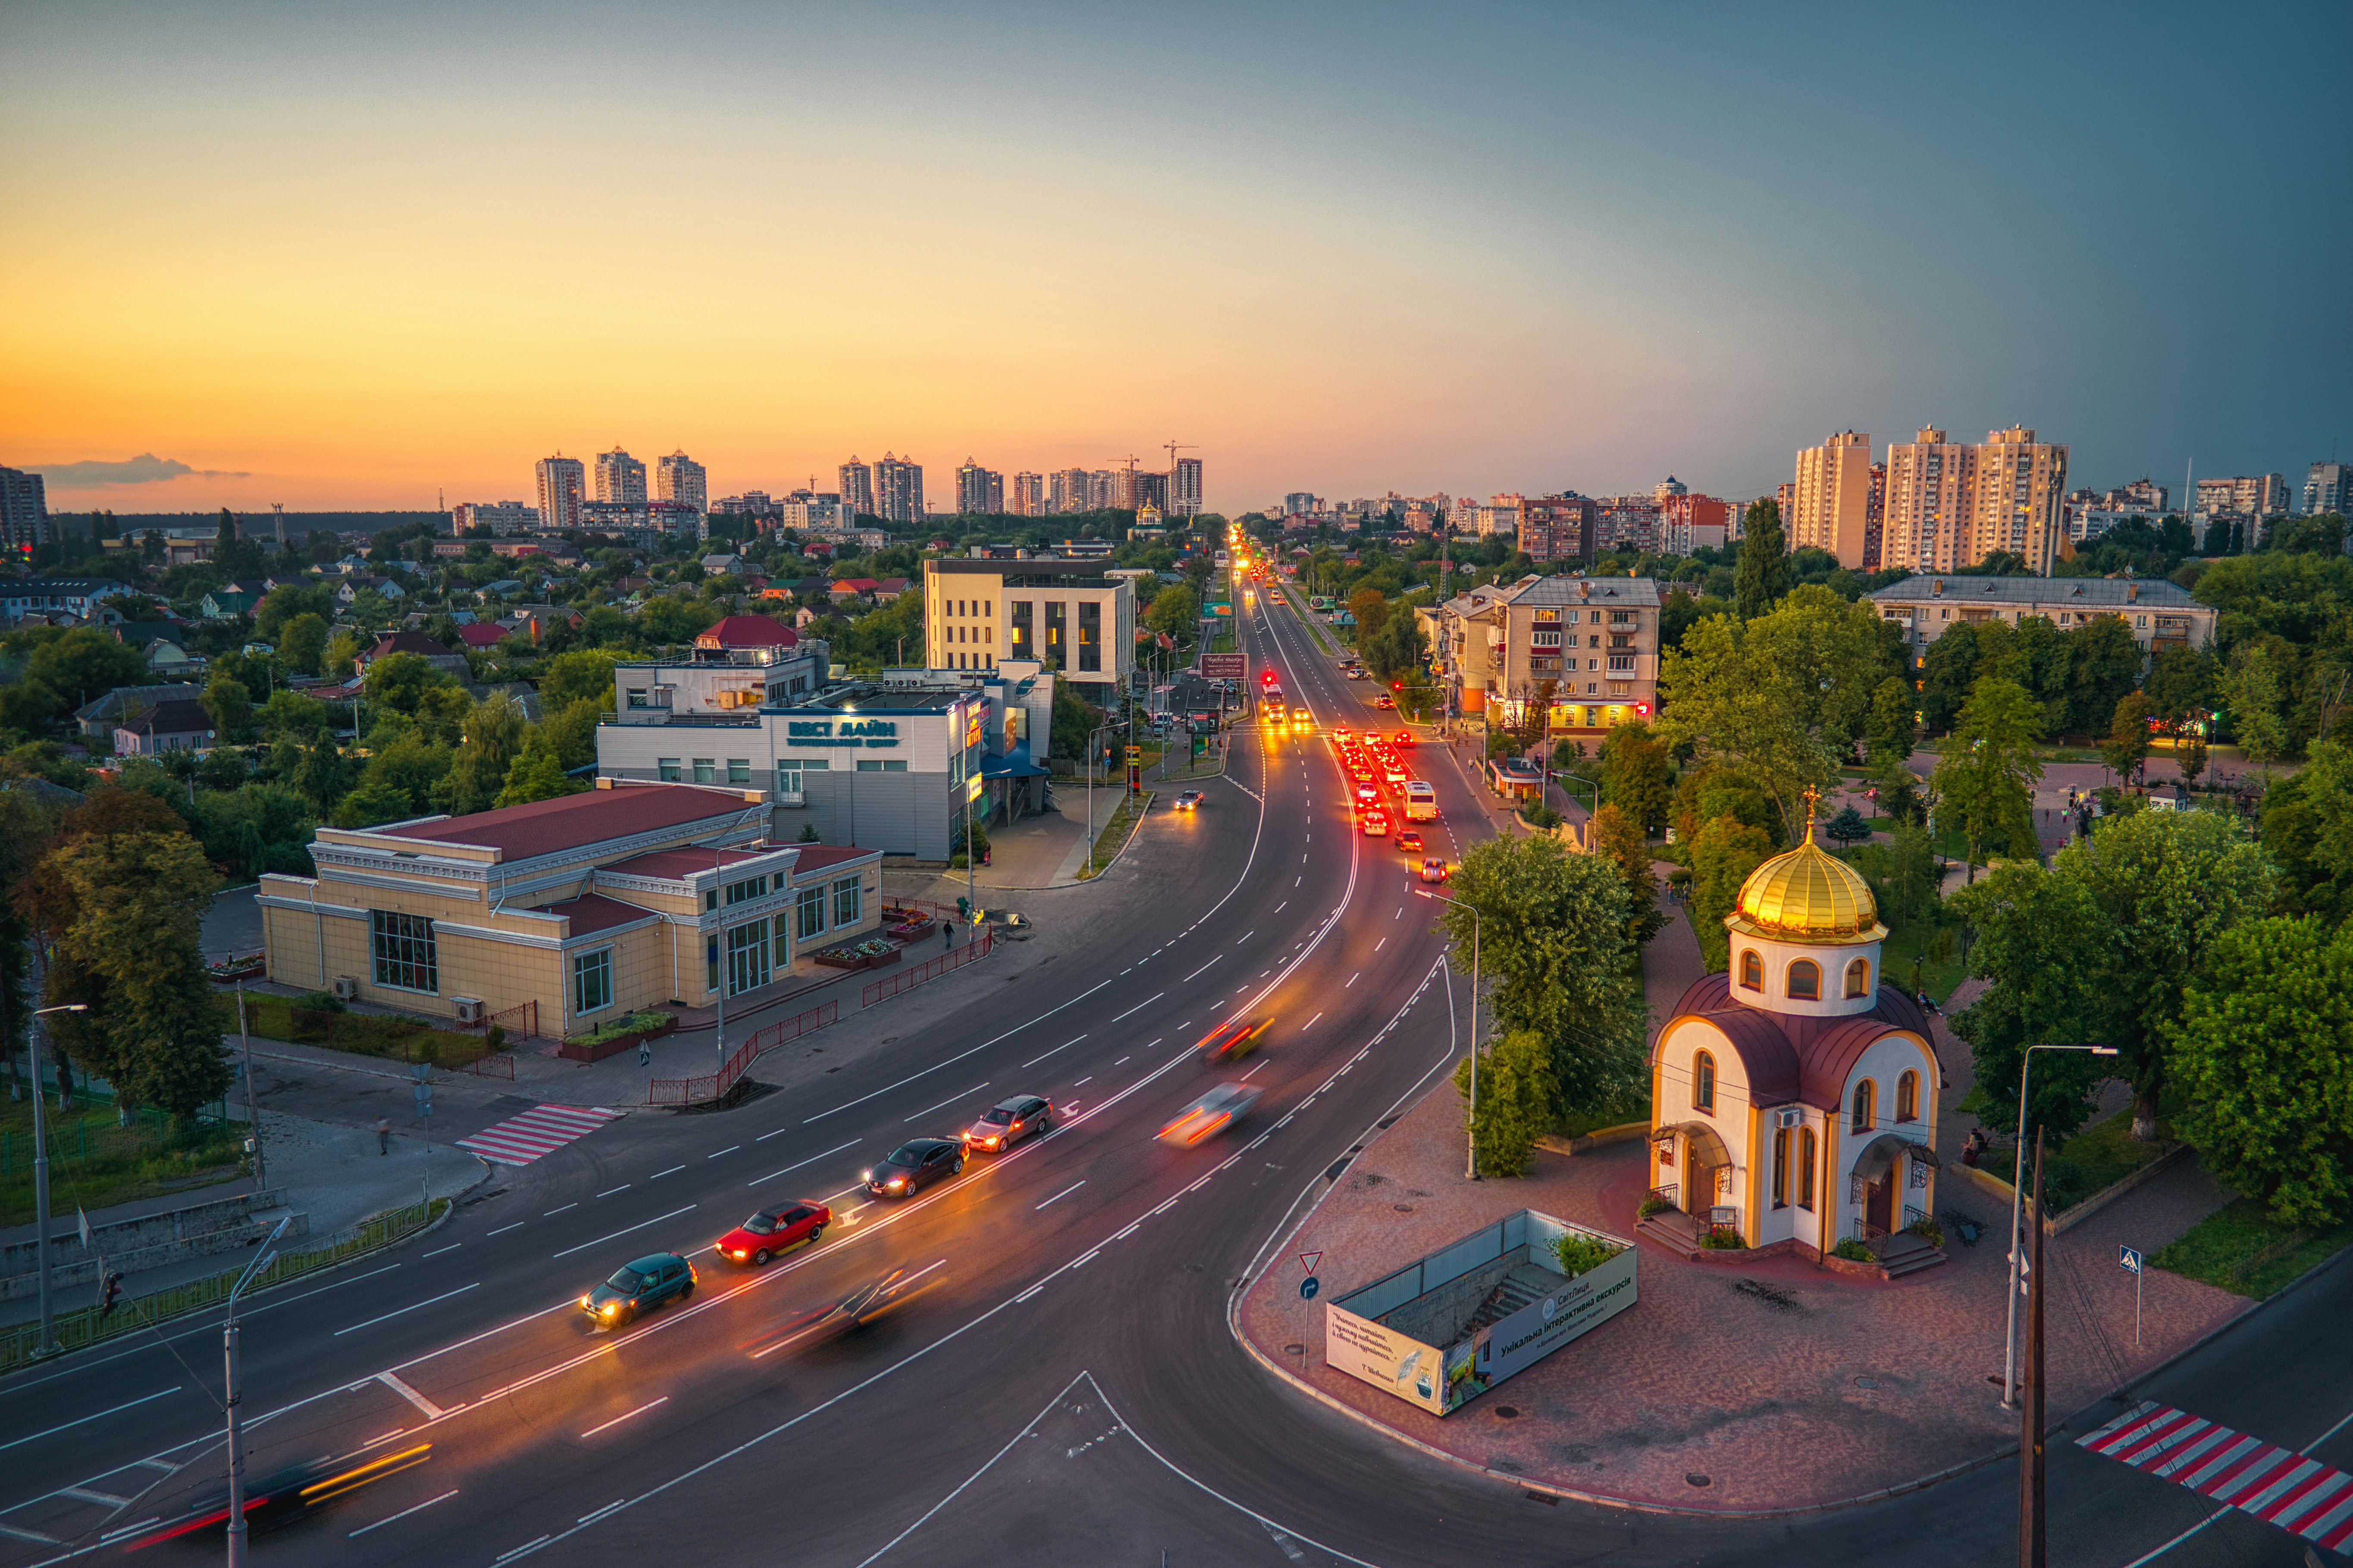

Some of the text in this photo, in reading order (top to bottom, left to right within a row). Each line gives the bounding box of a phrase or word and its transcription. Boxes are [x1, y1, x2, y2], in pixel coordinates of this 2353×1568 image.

[789, 719, 895, 736] ВЕСТ ЛАЙН
[786, 737, 899, 748] ТОРГІВЕЛЬНИЙ ЦЕНТР
[1558, 1282, 1589, 1305] СвітЛиця
[1501, 1328, 1542, 1357] Унікальна
[1545, 1298, 1595, 1333] інтерактивна
[1596, 1277, 1631, 1302] екскурсія
[1335, 1324, 1357, 1340] чужому
[1358, 1334, 1393, 1354] навчайтесь,
[1337, 1332, 1351, 1343] свого
[1360, 1325, 1387, 1342] читайте,
[1367, 1366, 1394, 1383] Шевченко
